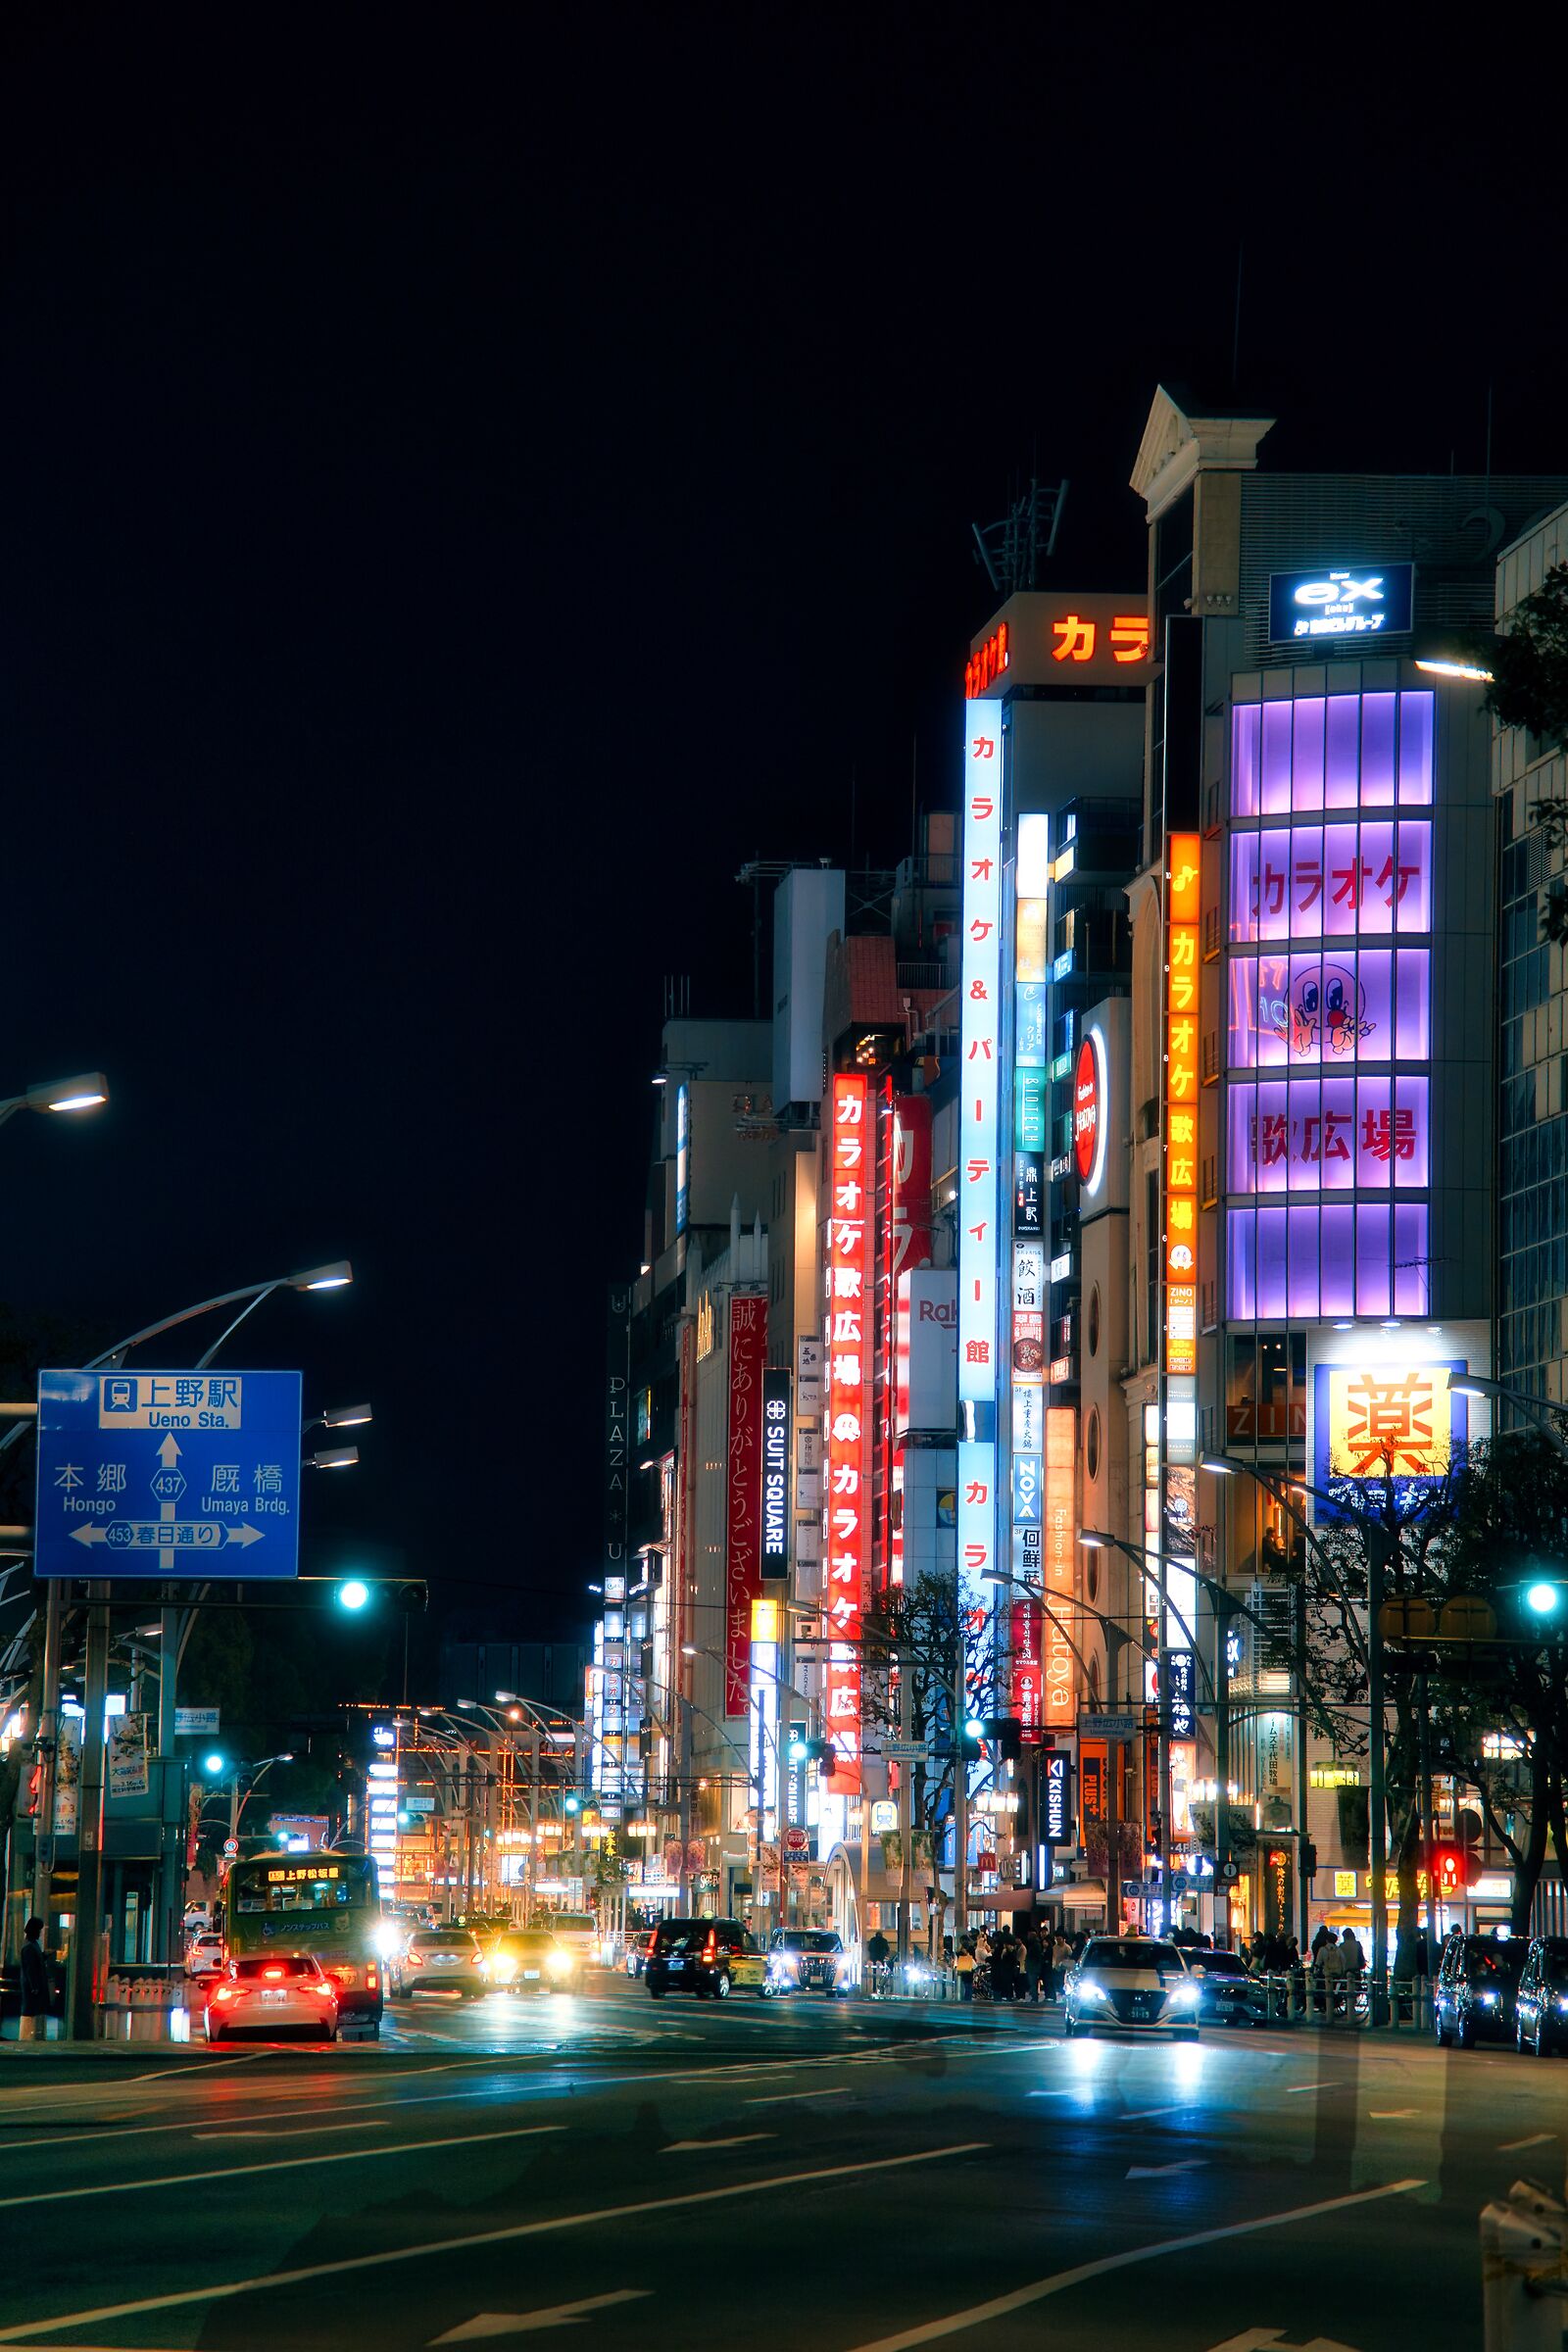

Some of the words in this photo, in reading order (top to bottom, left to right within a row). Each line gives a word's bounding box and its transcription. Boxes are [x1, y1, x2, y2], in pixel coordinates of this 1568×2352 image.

[1053, 615, 1149, 662] カラ
[1252, 855, 1419, 916] カラオケ
[1170, 932, 1195, 1229] カラオケ歌広場
[1025, 1078, 1039, 1142] BIOTECH
[1251, 1109, 1416, 1166] 歌広場
[832, 1095, 862, 1385] カラオケ歌広場
[1171, 1288, 1192, 1297] ZINO
[141, 1379, 238, 1408] 上野駅
[149, 1412, 191, 1428] Ueno
[198, 1412, 229, 1428] Sta.
[1348, 1373, 1432, 1474] 薬
[767, 1426, 784, 1470] SUIT
[54, 1463, 126, 1493] 本郷
[156, 1478, 181, 1494] 437
[1019, 1461, 1035, 1517] NOVA
[63, 1496, 116, 1514] Hongo
[202, 1497, 248, 1515] Umaya
[255, 1497, 290, 1514] Brdg.
[766, 1474, 783, 1554] SQUARE
[109, 1529, 130, 1542] 453
[136, 1527, 214, 1544] 春日通り
[1054, 1509, 1066, 1576] Fashion-in
[1046, 1596, 1071, 1705] Hatoya
[1049, 1779, 1061, 1838] KISHUN
[280, 1922, 329, 1932] ノンステップバス
